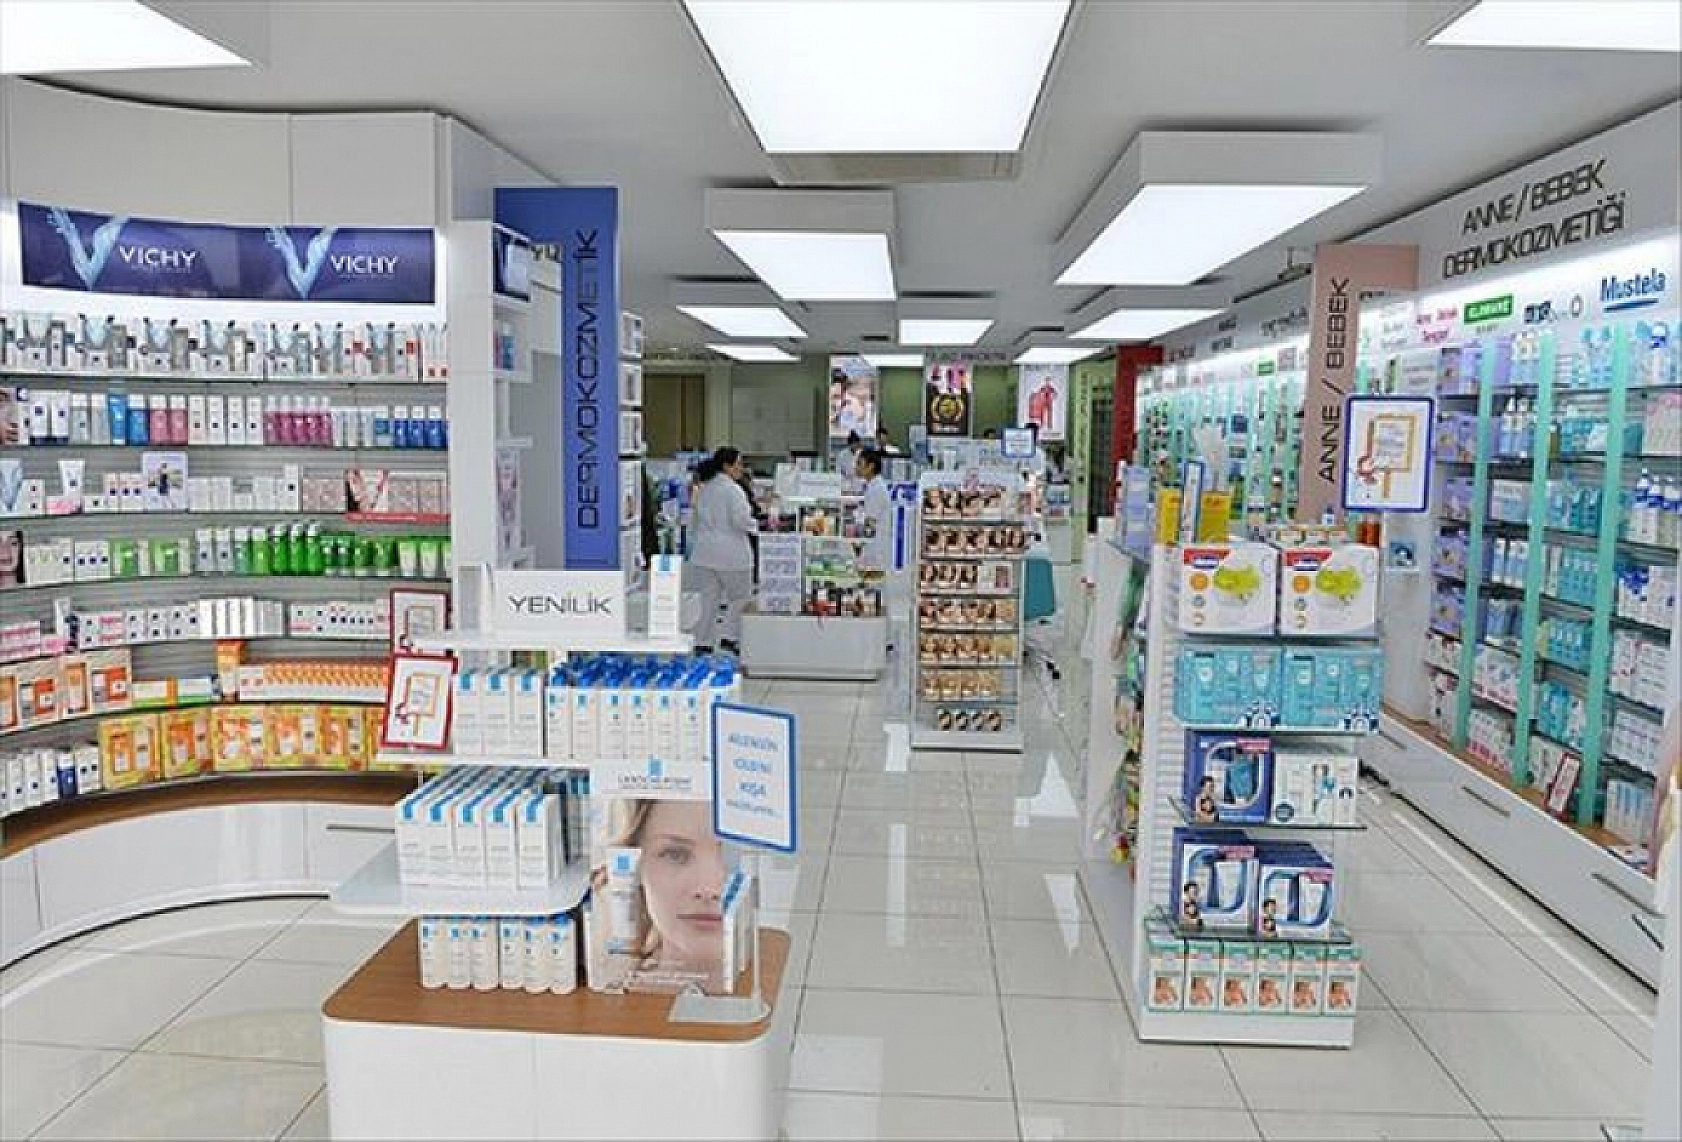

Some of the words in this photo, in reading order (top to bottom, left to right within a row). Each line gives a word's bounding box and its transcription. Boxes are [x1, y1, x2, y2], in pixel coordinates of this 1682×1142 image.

[1442, 189, 1627, 280] DERMOKOZMETİĞİ
[1462, 193, 1515, 236] ANNE
[1531, 156, 1608, 212] BEBEK
[119, 245, 197, 268] VICHY
[330, 254, 398, 275] VICHY
[1600, 269, 1667, 301] Mustela
[1326, 277, 1350, 370] BEBEK
[573, 228, 600, 530] DERMOKOZMETİK
[1318, 404, 1342, 485] ANNE
[508, 591, 613, 614] YENİLİK
